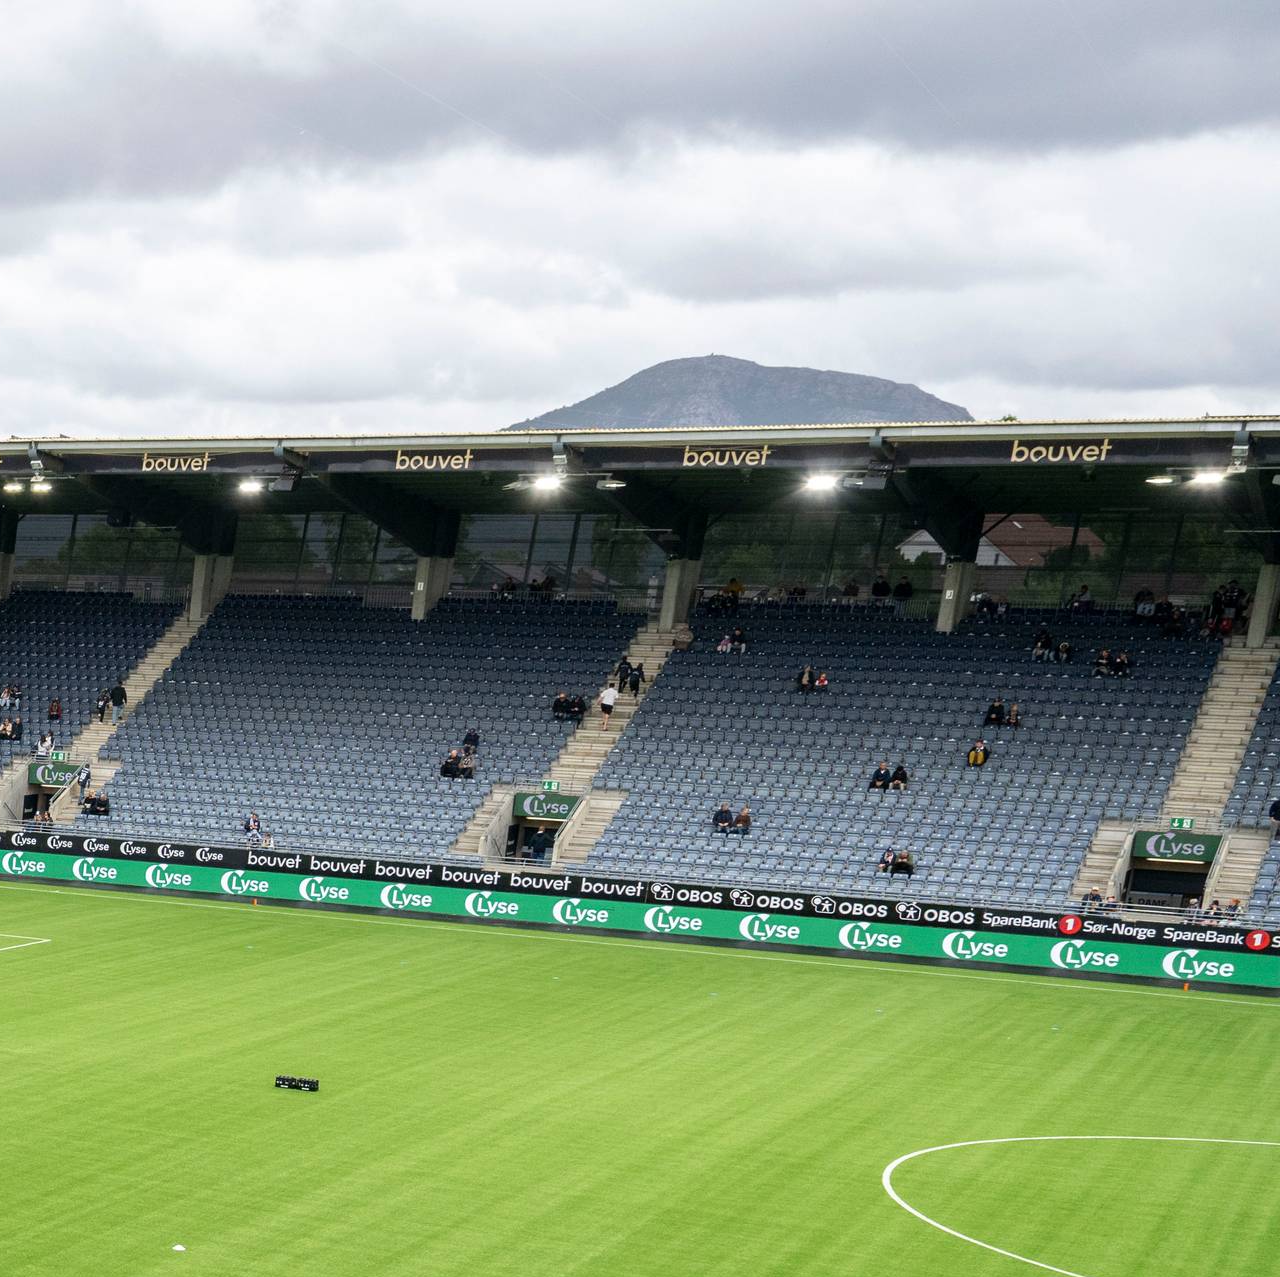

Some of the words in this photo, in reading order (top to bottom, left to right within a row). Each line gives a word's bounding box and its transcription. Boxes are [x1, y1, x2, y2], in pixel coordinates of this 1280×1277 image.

[395, 448, 474, 470] bouvet
[682, 443, 771, 468] bouvet
[1010, 438, 1112, 464] bouvet
[141, 451, 212, 473] bouvet
[44, 767, 74, 784] Lyse
[533, 799, 569, 818] Lyse
[18, 835, 37, 848] Lyse
[54, 838, 73, 850] Lyse
[91, 840, 110, 853] Lyse
[127, 843, 147, 856] Lyse
[1159, 838, 1206, 858] Lyse
[166, 846, 185, 859] Lyse
[203, 849, 224, 862] Lyse
[247, 851, 302, 869] bouvet
[12, 854, 46, 875] Lyse
[83, 860, 117, 881] Lyse
[310, 856, 366, 874] bouvet
[375, 861, 432, 880] bouvet
[156, 867, 192, 888] Lyse
[231, 873, 269, 894] Lyse
[441, 866, 500, 885] bouvet
[510, 871, 571, 891] bouvet
[311, 881, 349, 902] Lyse
[581, 877, 644, 897] bouvet
[676, 888, 723, 904] OBOS
[392, 888, 432, 909] Lyse
[477, 896, 519, 917] Lyse
[756, 895, 804, 911] OBOS
[566, 903, 609, 924] Lyse
[838, 902, 888, 918] OBOS
[924, 908, 975, 925] OBOS
[657, 911, 702, 932] Lyse
[753, 919, 800, 941] Lyse
[982, 912, 1057, 929] SpareBank
[1083, 920, 1156, 940] Sør-Norge
[852, 927, 902, 950] Lyse
[957, 936, 1009, 959] Lyse
[1163, 927, 1244, 948] SpareBank
[1066, 946, 1120, 968] Lyse
[1178, 955, 1235, 978] Lyse
